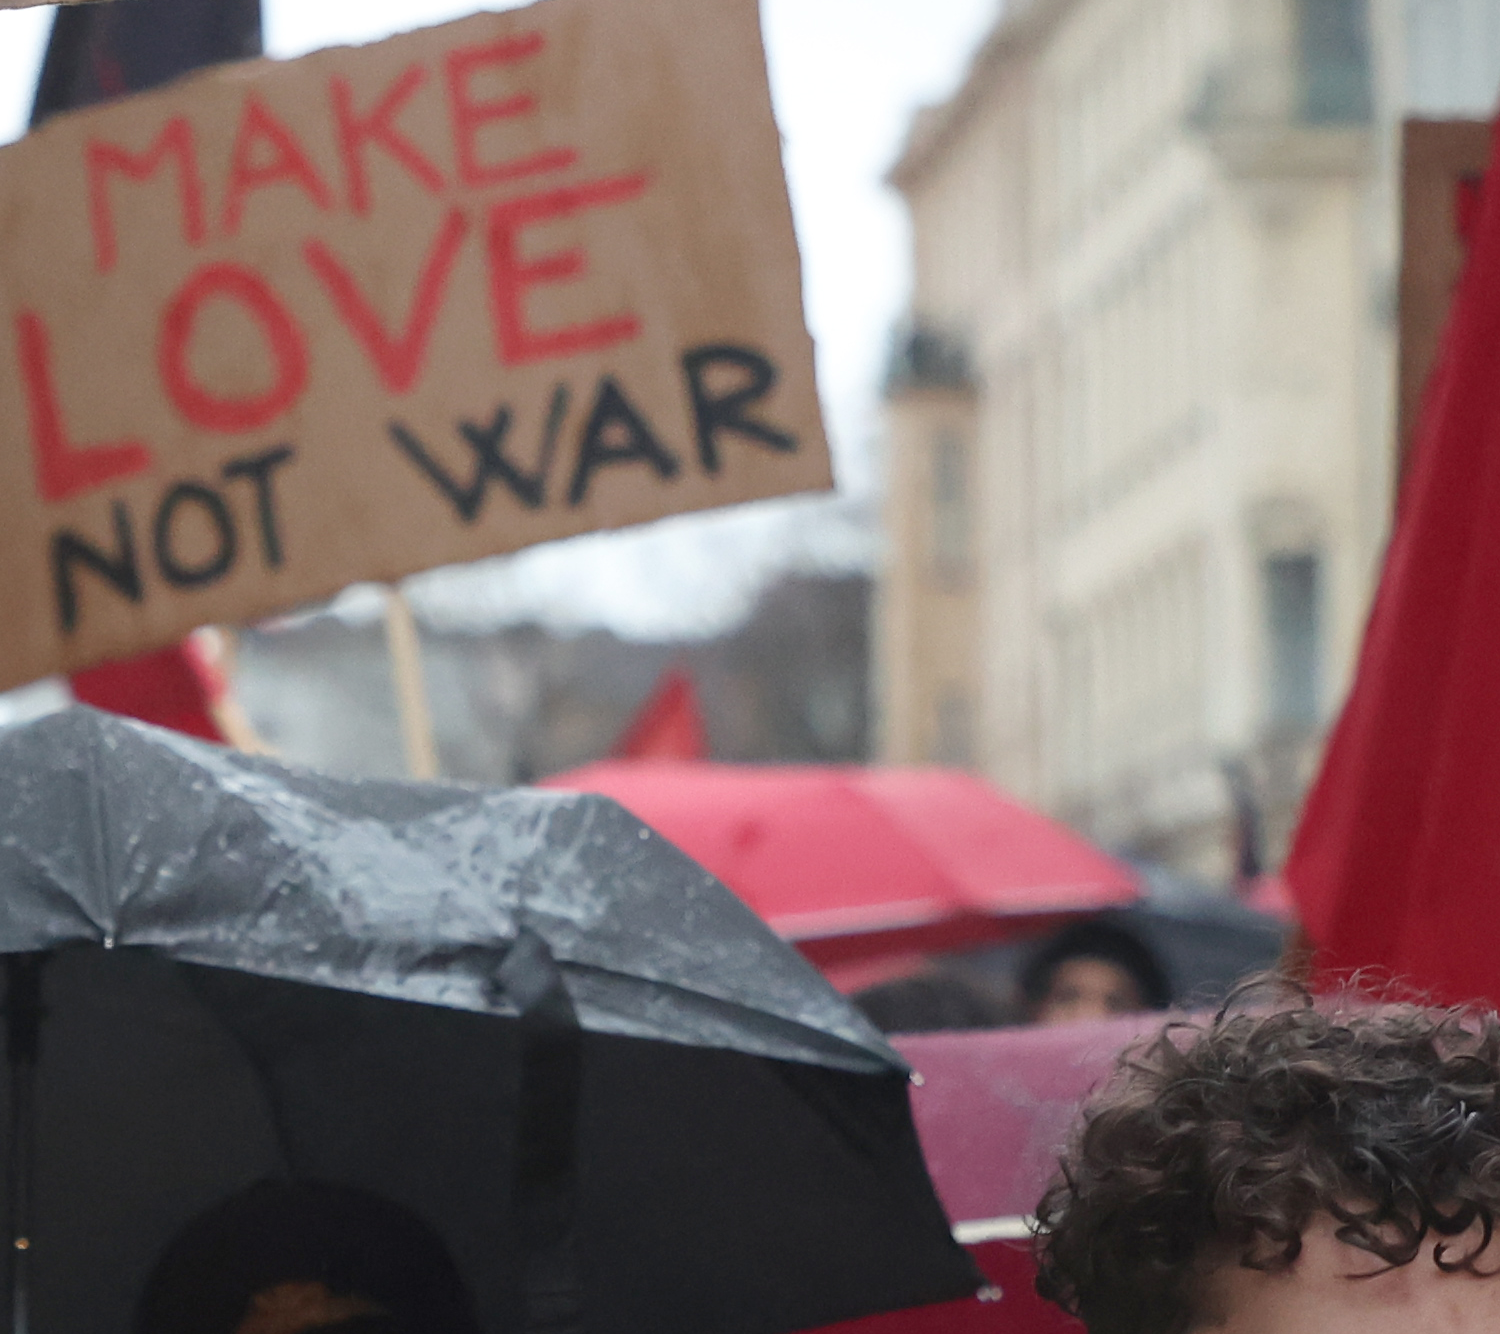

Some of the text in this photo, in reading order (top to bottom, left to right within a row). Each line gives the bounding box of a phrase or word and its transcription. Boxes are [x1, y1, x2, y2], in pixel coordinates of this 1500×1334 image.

[83, 30, 578, 275] MAKE
[14, 168, 650, 503] LOVE
[48, 340, 801, 632] NOT WAR
